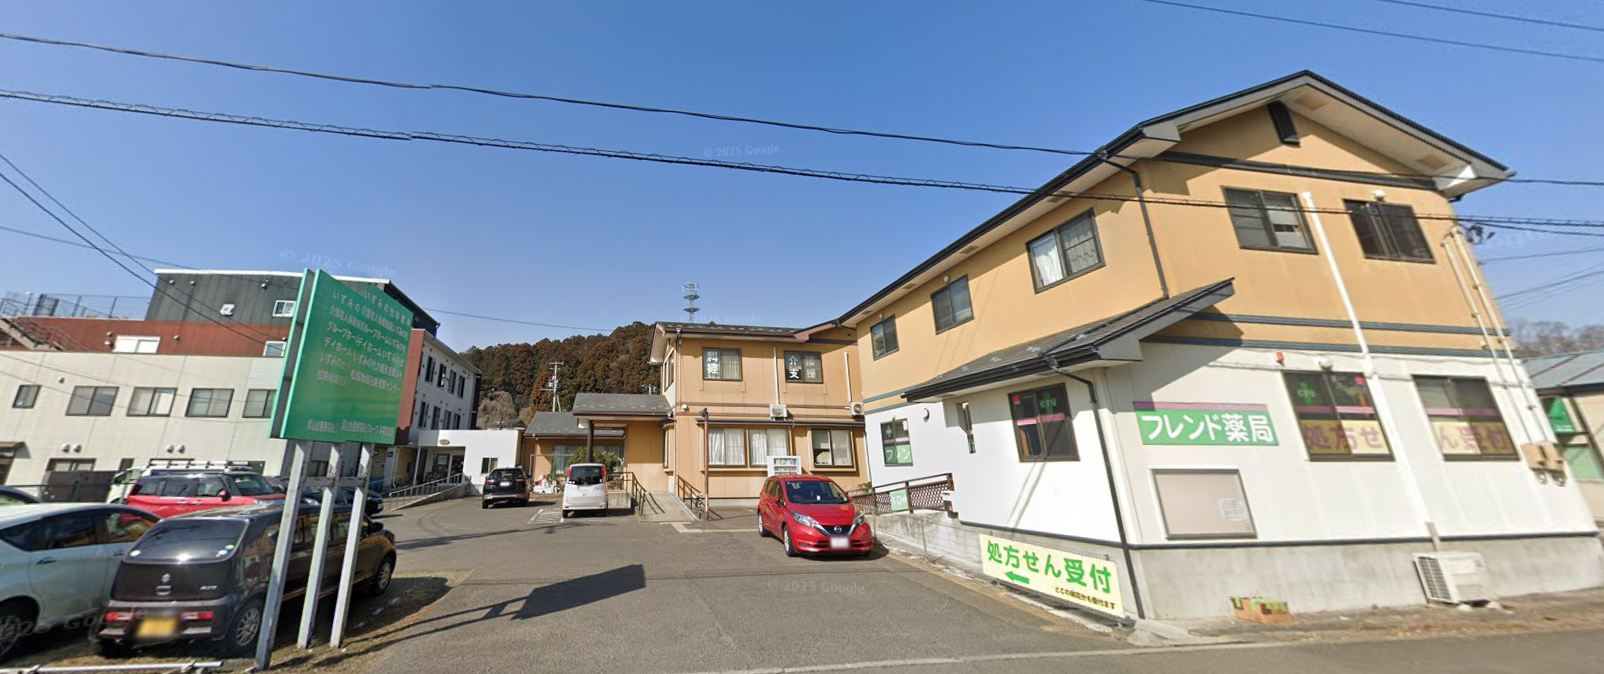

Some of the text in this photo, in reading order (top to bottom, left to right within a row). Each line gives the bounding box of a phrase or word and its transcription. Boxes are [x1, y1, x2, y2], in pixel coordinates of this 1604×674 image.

[1141, 412, 1275, 443] フレンド薬局
[987, 539, 1111, 594] 処方せん受付
